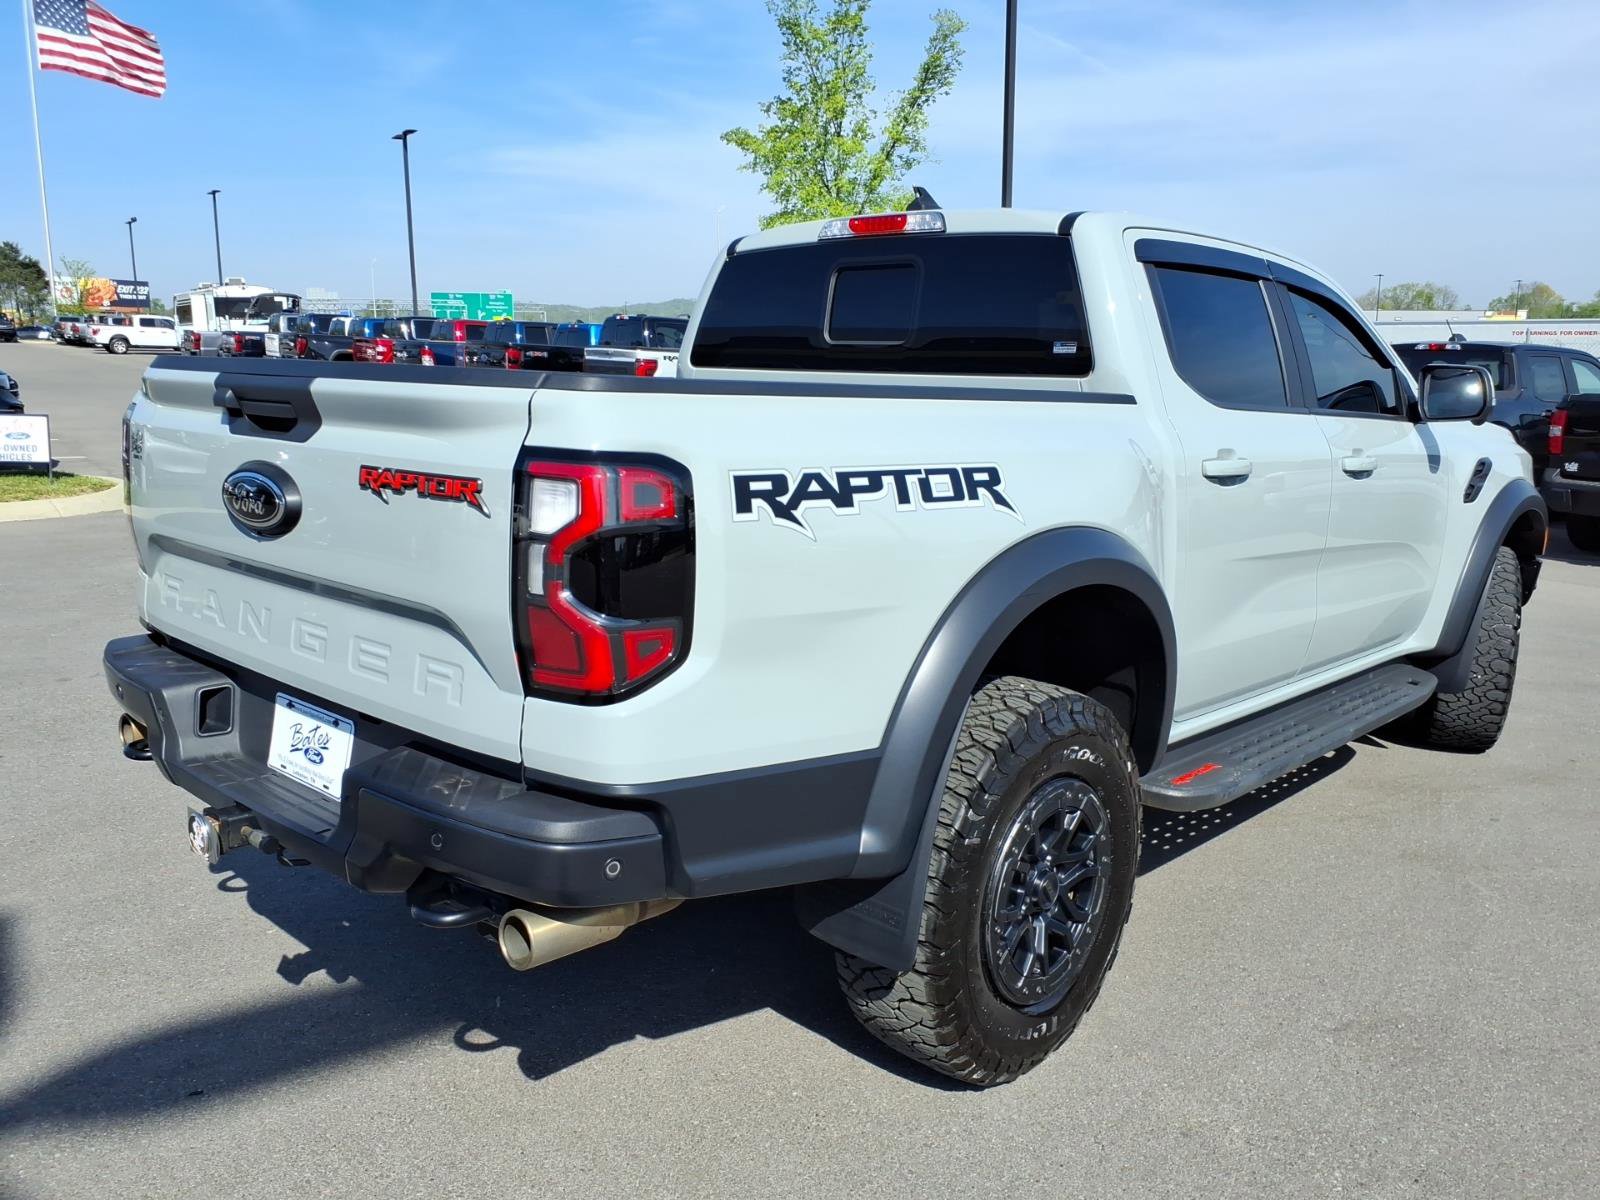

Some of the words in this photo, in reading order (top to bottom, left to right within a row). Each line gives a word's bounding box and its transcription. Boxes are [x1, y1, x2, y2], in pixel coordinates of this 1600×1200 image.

[117, 285, 134, 294] EXIT
[232, 482, 266, 516] Ford
[358, 464, 491, 519] RAPTOR
[730, 464, 1022, 537] RAPTOR
[159, 572, 465, 708] RANGER
[290, 723, 332, 749] Bates
